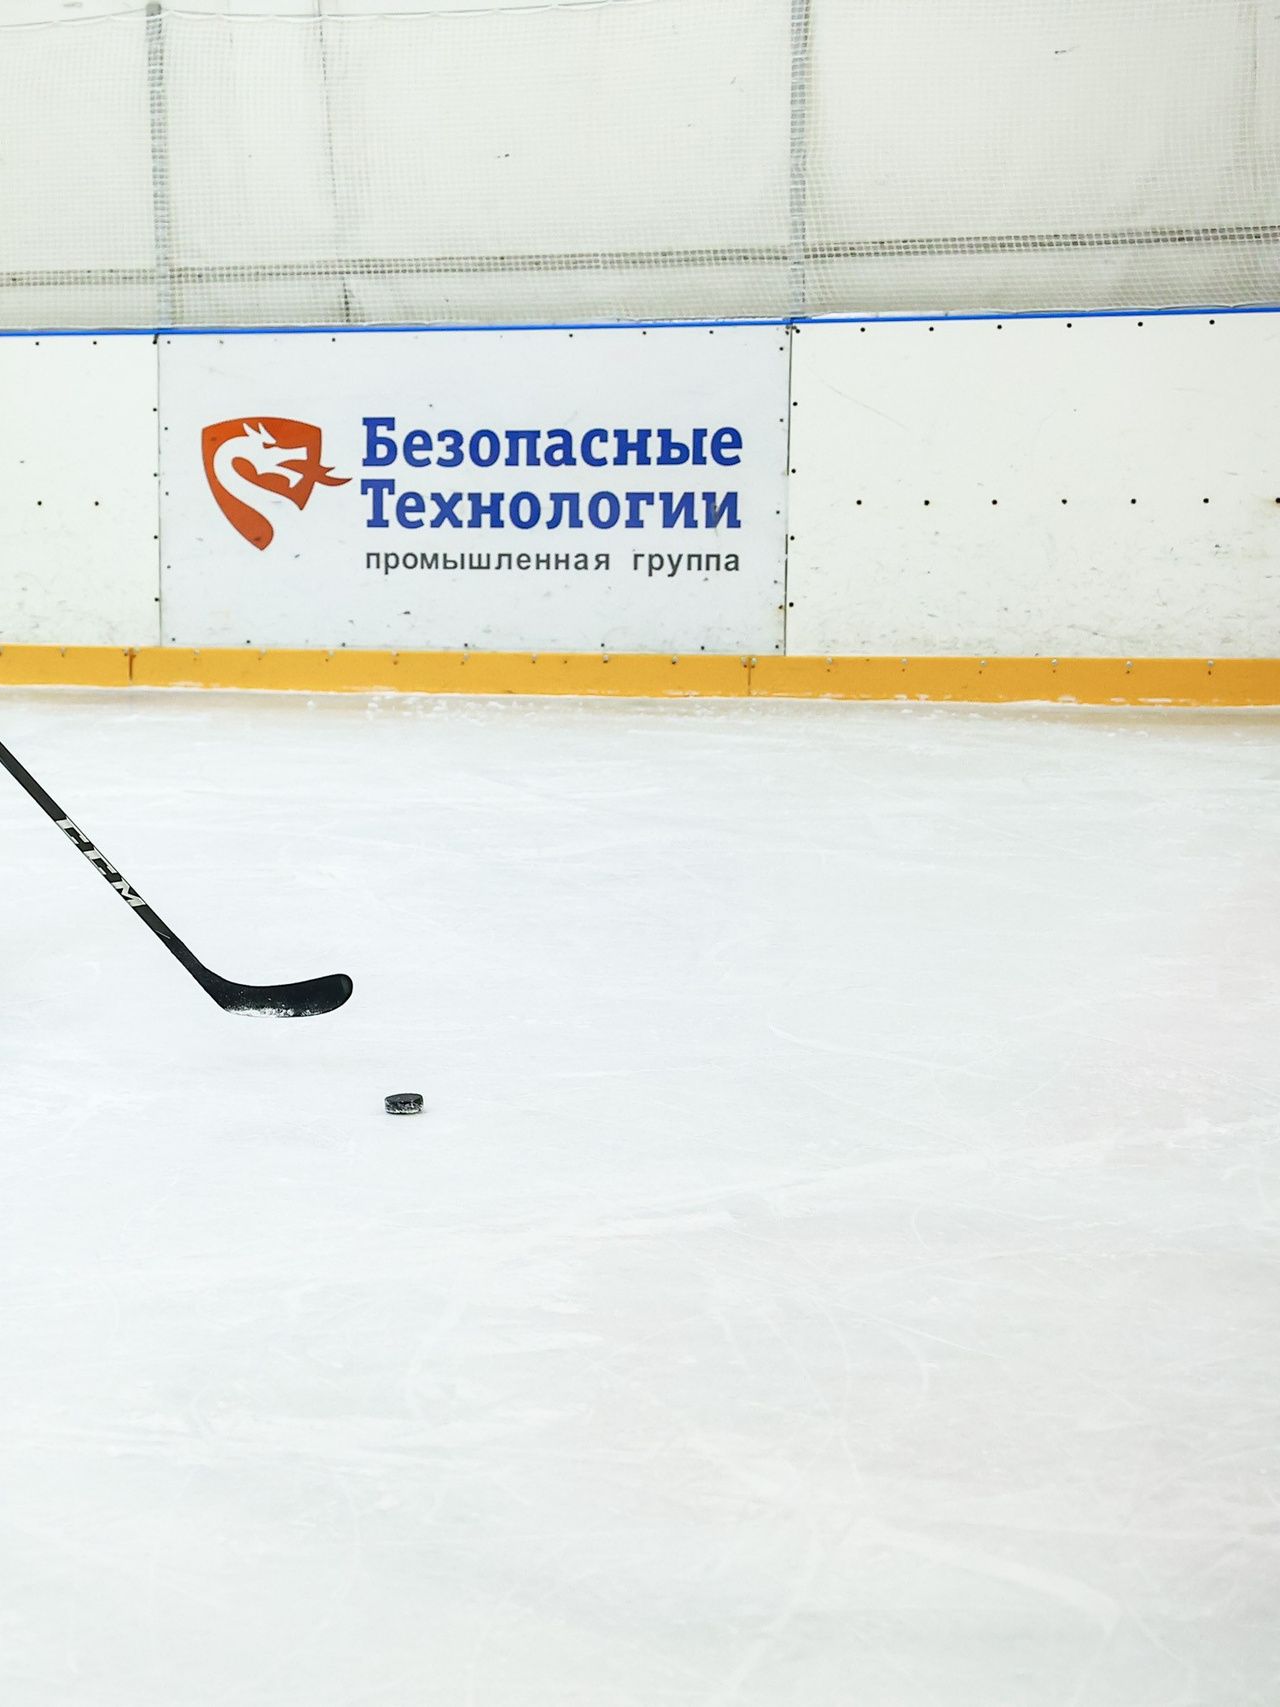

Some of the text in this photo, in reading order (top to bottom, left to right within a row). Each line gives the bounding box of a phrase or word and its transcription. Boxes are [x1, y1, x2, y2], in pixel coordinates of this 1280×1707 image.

[361, 416, 743, 467] Безопасные
[360, 478, 742, 530] Технологии
[366, 551, 740, 576] промышленная группа
[56, 815, 147, 908] CCM
